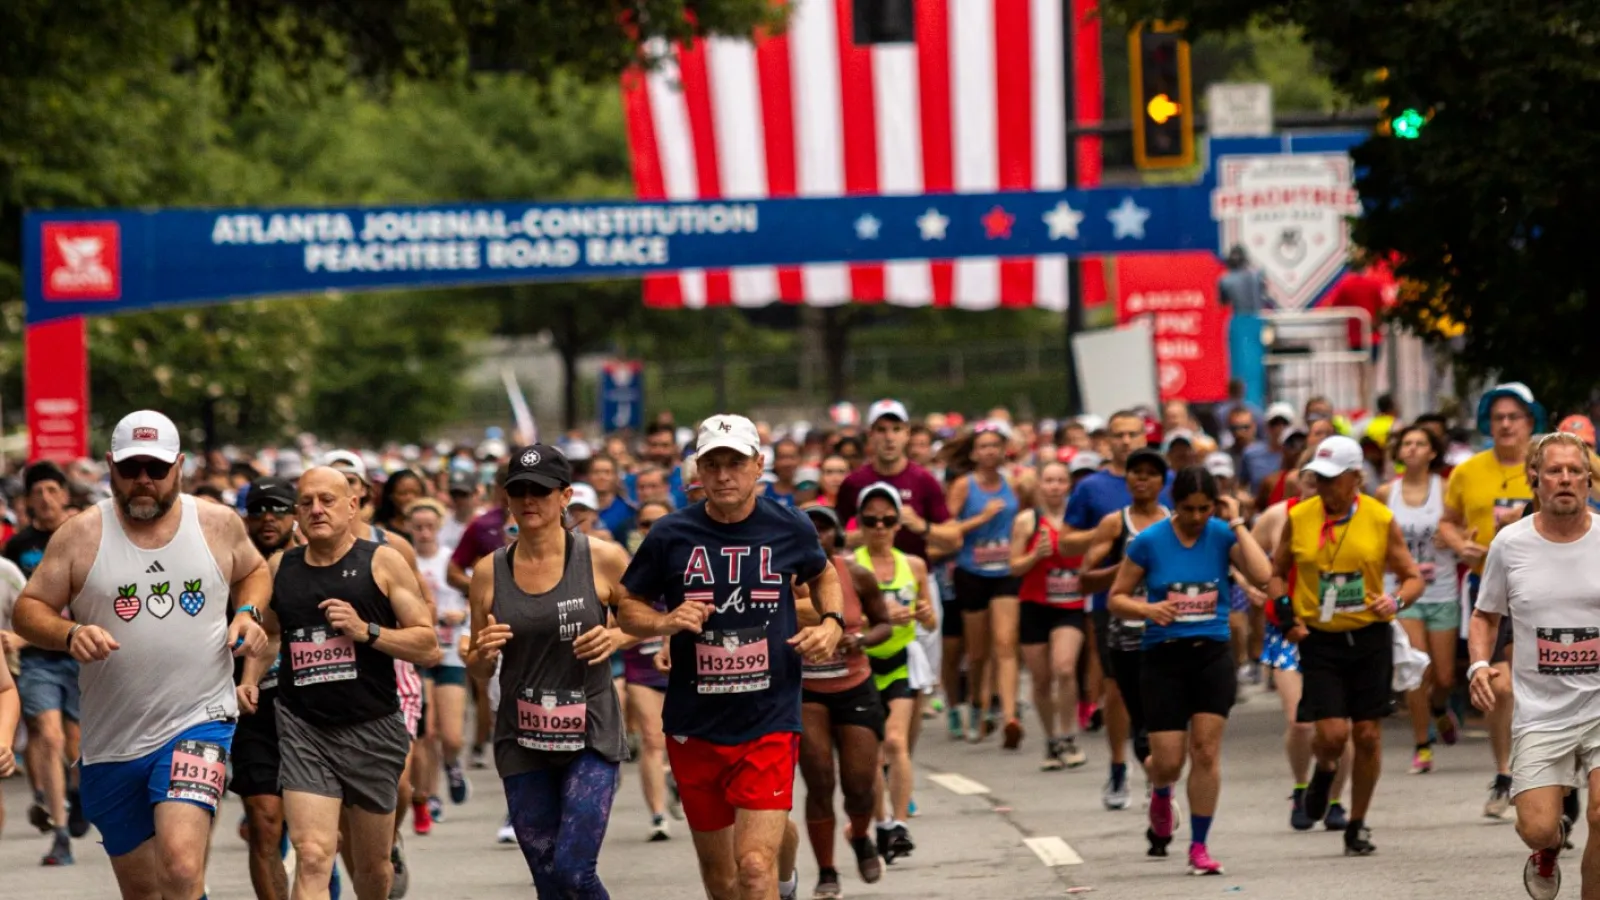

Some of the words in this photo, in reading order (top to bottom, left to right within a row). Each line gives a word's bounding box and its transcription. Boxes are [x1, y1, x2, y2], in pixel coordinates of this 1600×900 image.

[212, 214, 354, 244] ATLANTA
[359, 203, 758, 241] JOURNAL-CONSTITUTION
[304, 240, 479, 272] PEACHTREE
[486, 239, 580, 268] ROAD
[585, 236, 669, 265] RACE
[684, 546, 782, 585] ATL
[557, 598, 585, 613] WORK
[559, 613, 567, 624] IT
[560, 622, 582, 637] OUT
[293, 647, 353, 666] H29894
[700, 654, 766, 671] H32599
[1539, 649, 1598, 662] H29322
[520, 711, 583, 729] H31059
